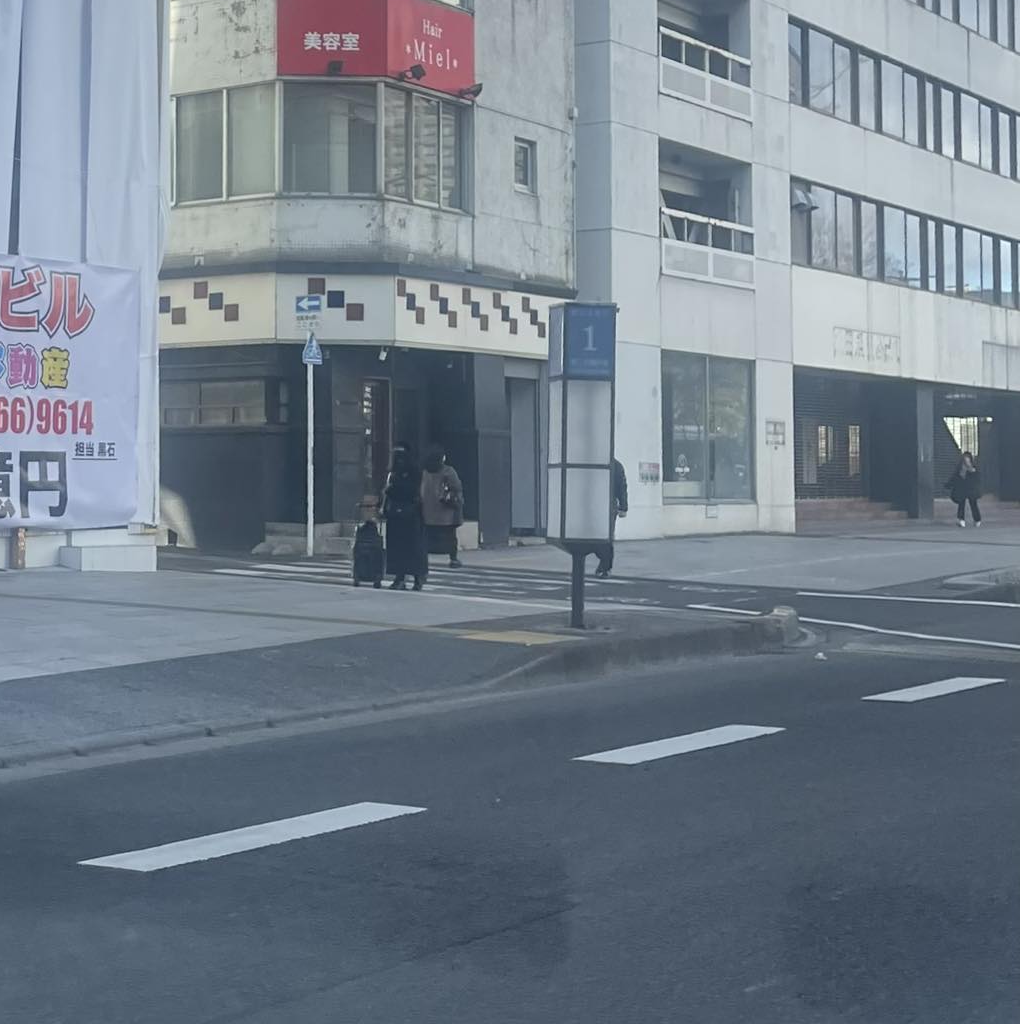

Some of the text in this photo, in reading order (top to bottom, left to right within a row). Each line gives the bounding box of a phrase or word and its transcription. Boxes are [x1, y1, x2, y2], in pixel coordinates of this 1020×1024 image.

[423, 19, 443, 38] Hair
[303, 32, 360, 51] 美容室
[412, 39, 450, 70] Miel
[582, 325, 597, 351] 1
